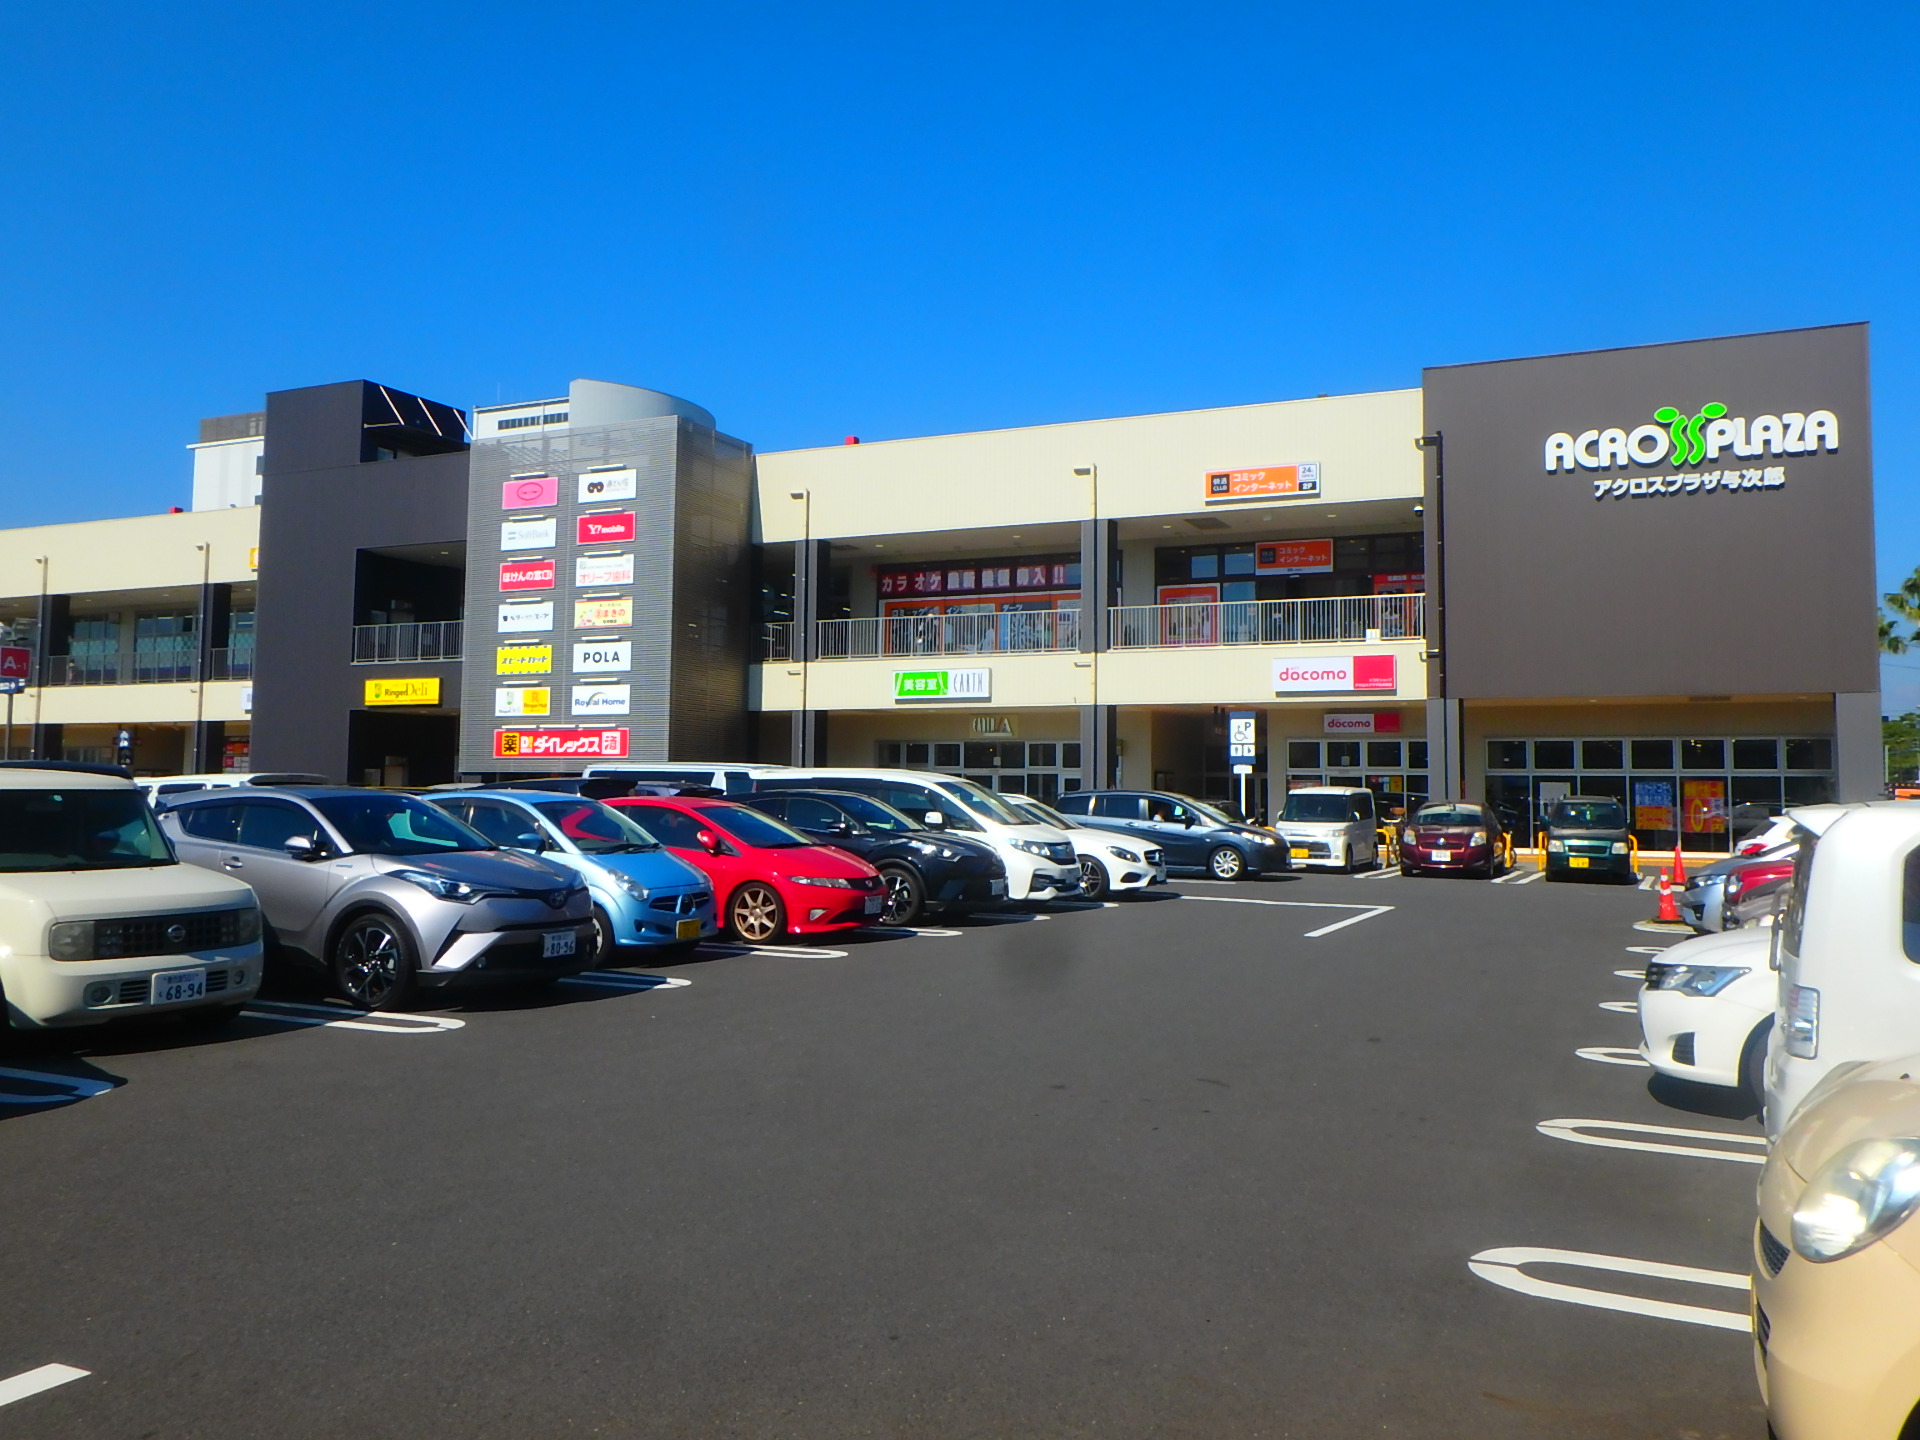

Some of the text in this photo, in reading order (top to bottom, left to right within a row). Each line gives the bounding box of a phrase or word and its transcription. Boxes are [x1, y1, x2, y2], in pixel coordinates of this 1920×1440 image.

[1545, 408, 1839, 471] ACROSS PLAZA
[1233, 471, 1265, 482] コミック
[1594, 467, 1785, 499] アクロスプラザ与次郎
[1233, 481, 1292, 493] インターネット
[502, 570, 552, 583] ほけんの窓口
[584, 651, 620, 664] POLA
[1279, 667, 1347, 682] docomo
[903, 679, 938, 691] 美容室
[575, 697, 626, 708] Royal Home
[1245, 721, 1252, 733] P
[1327, 718, 1371, 730] docomo
[504, 734, 518, 753] 薬
[534, 735, 600, 753] ダイレックス
[166, 982, 203, 1001] 68-94
